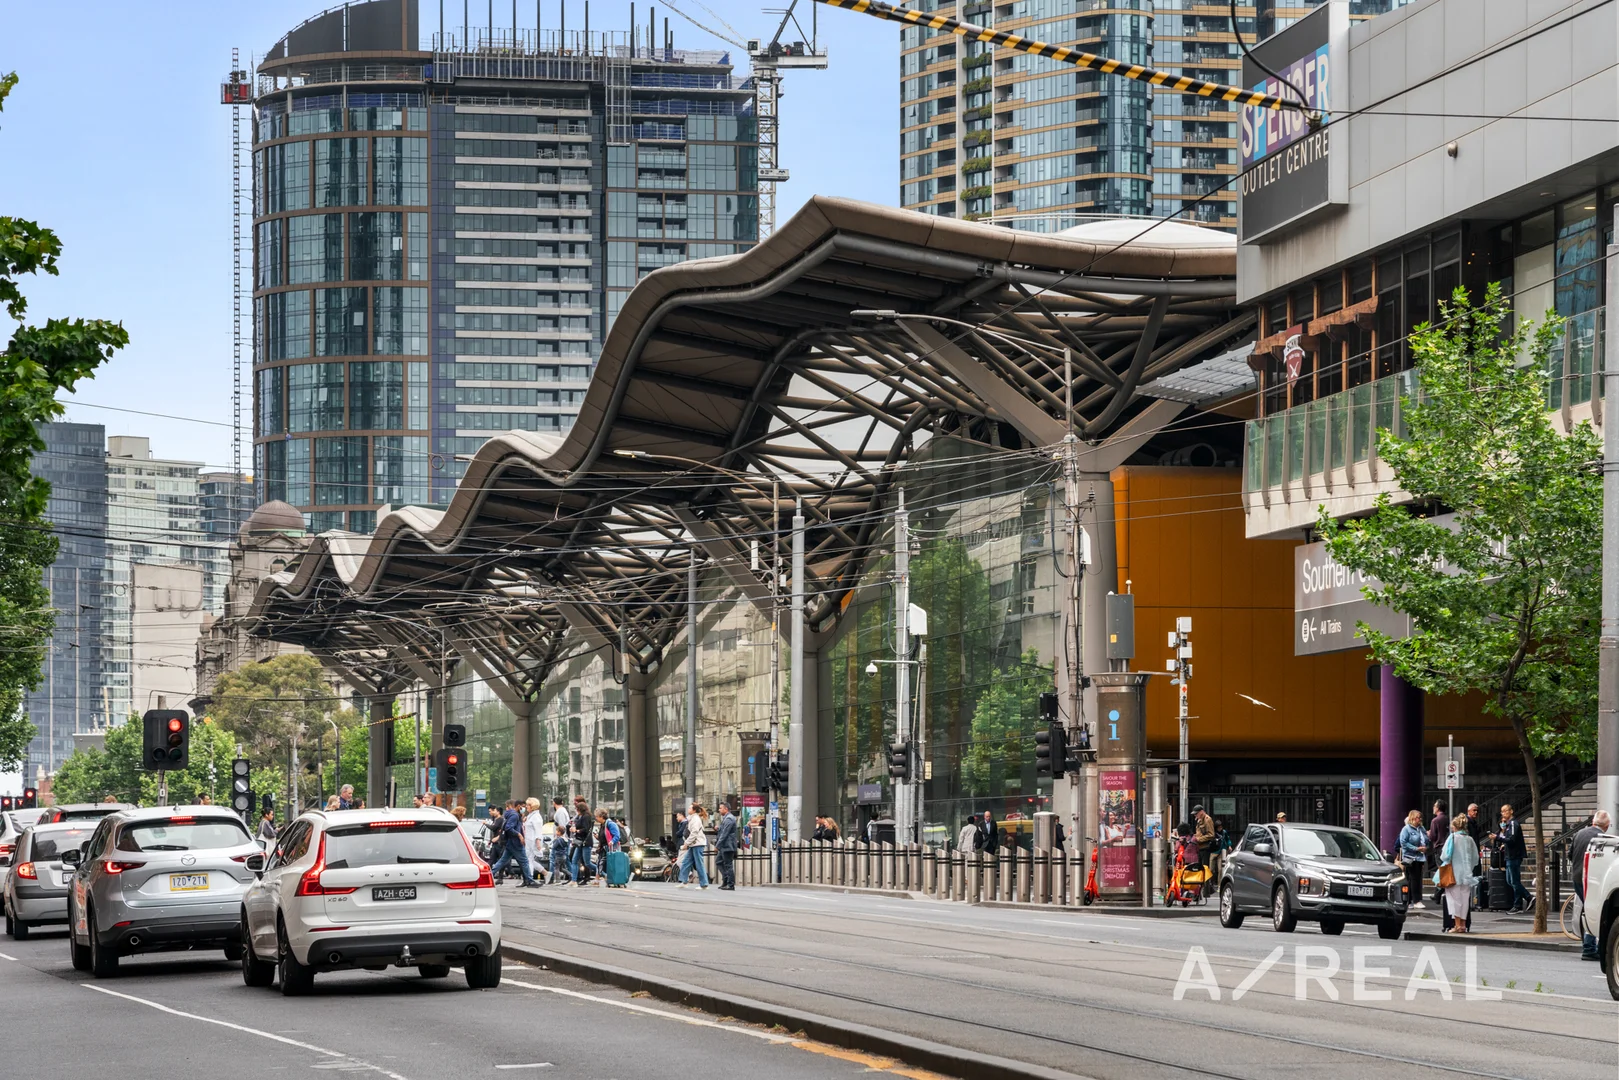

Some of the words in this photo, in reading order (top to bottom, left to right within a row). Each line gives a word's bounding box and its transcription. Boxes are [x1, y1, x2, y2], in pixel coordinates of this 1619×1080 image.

[1242, 53, 1329, 158] SPENCER
[1242, 153, 1282, 196] OUTLET
[1286, 129, 1329, 174] CENTRE
[1327, 619, 1342, 634] Trains
